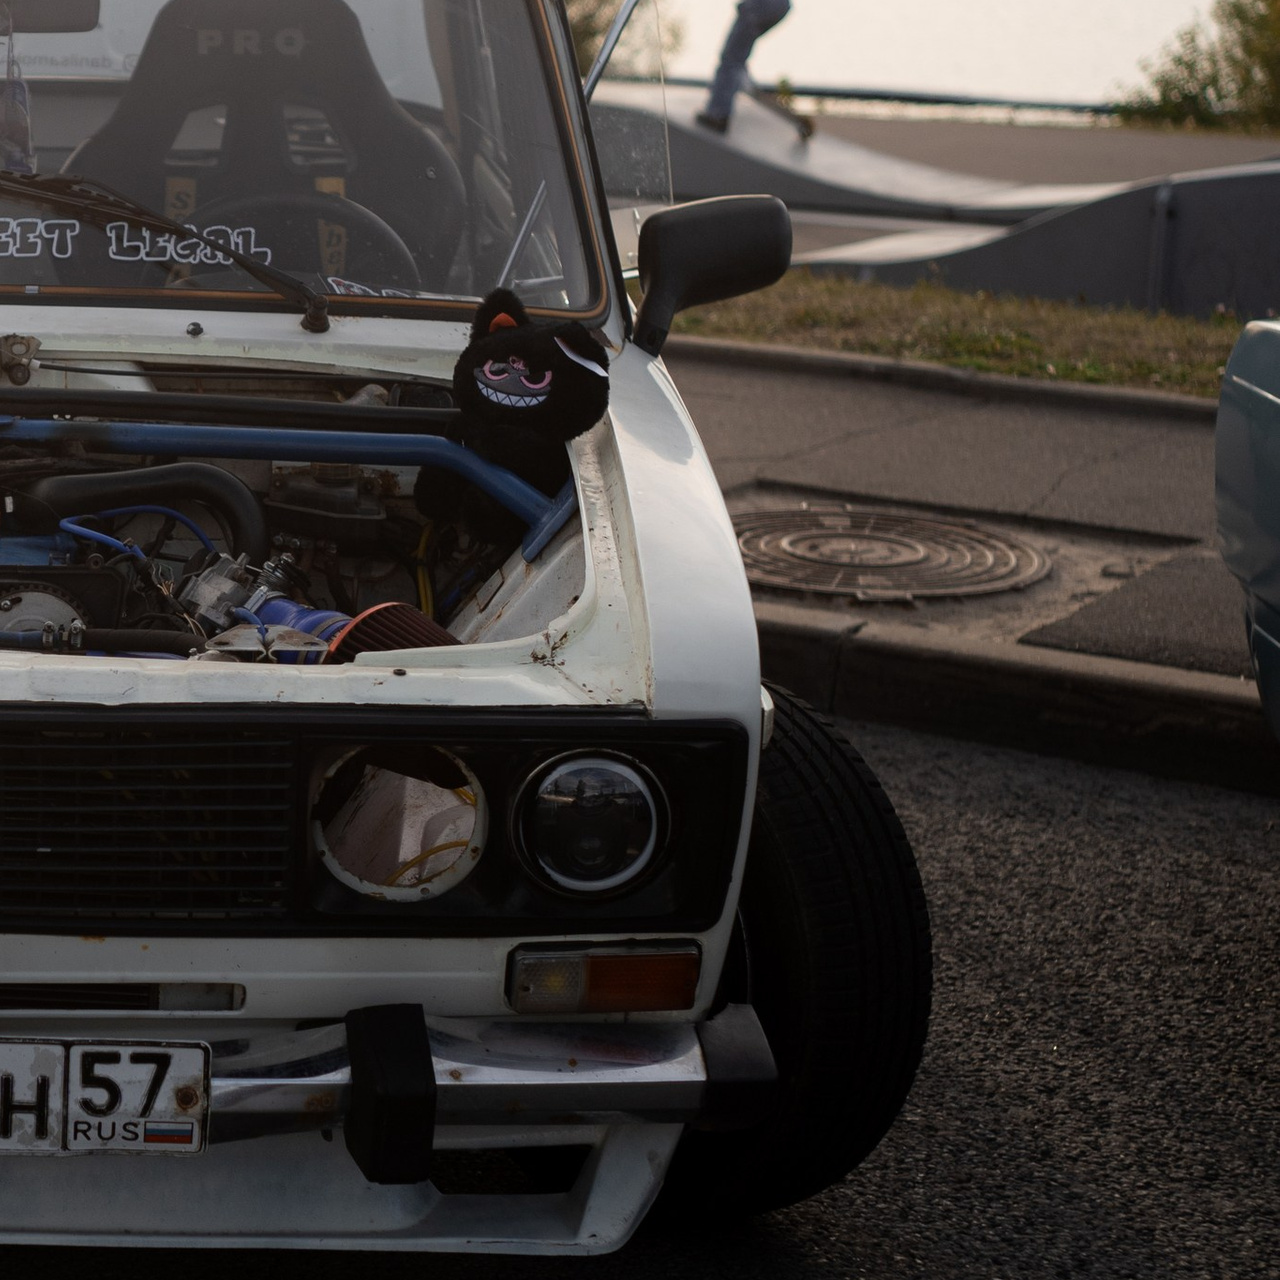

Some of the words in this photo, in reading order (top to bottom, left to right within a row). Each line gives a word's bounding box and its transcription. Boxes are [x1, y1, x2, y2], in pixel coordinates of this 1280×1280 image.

[196, 28, 306, 57] PRO
[107, 221, 272, 266] LEGAL
[78, 1051, 173, 1118] 57
[73, 1120, 140, 1143] RUS
